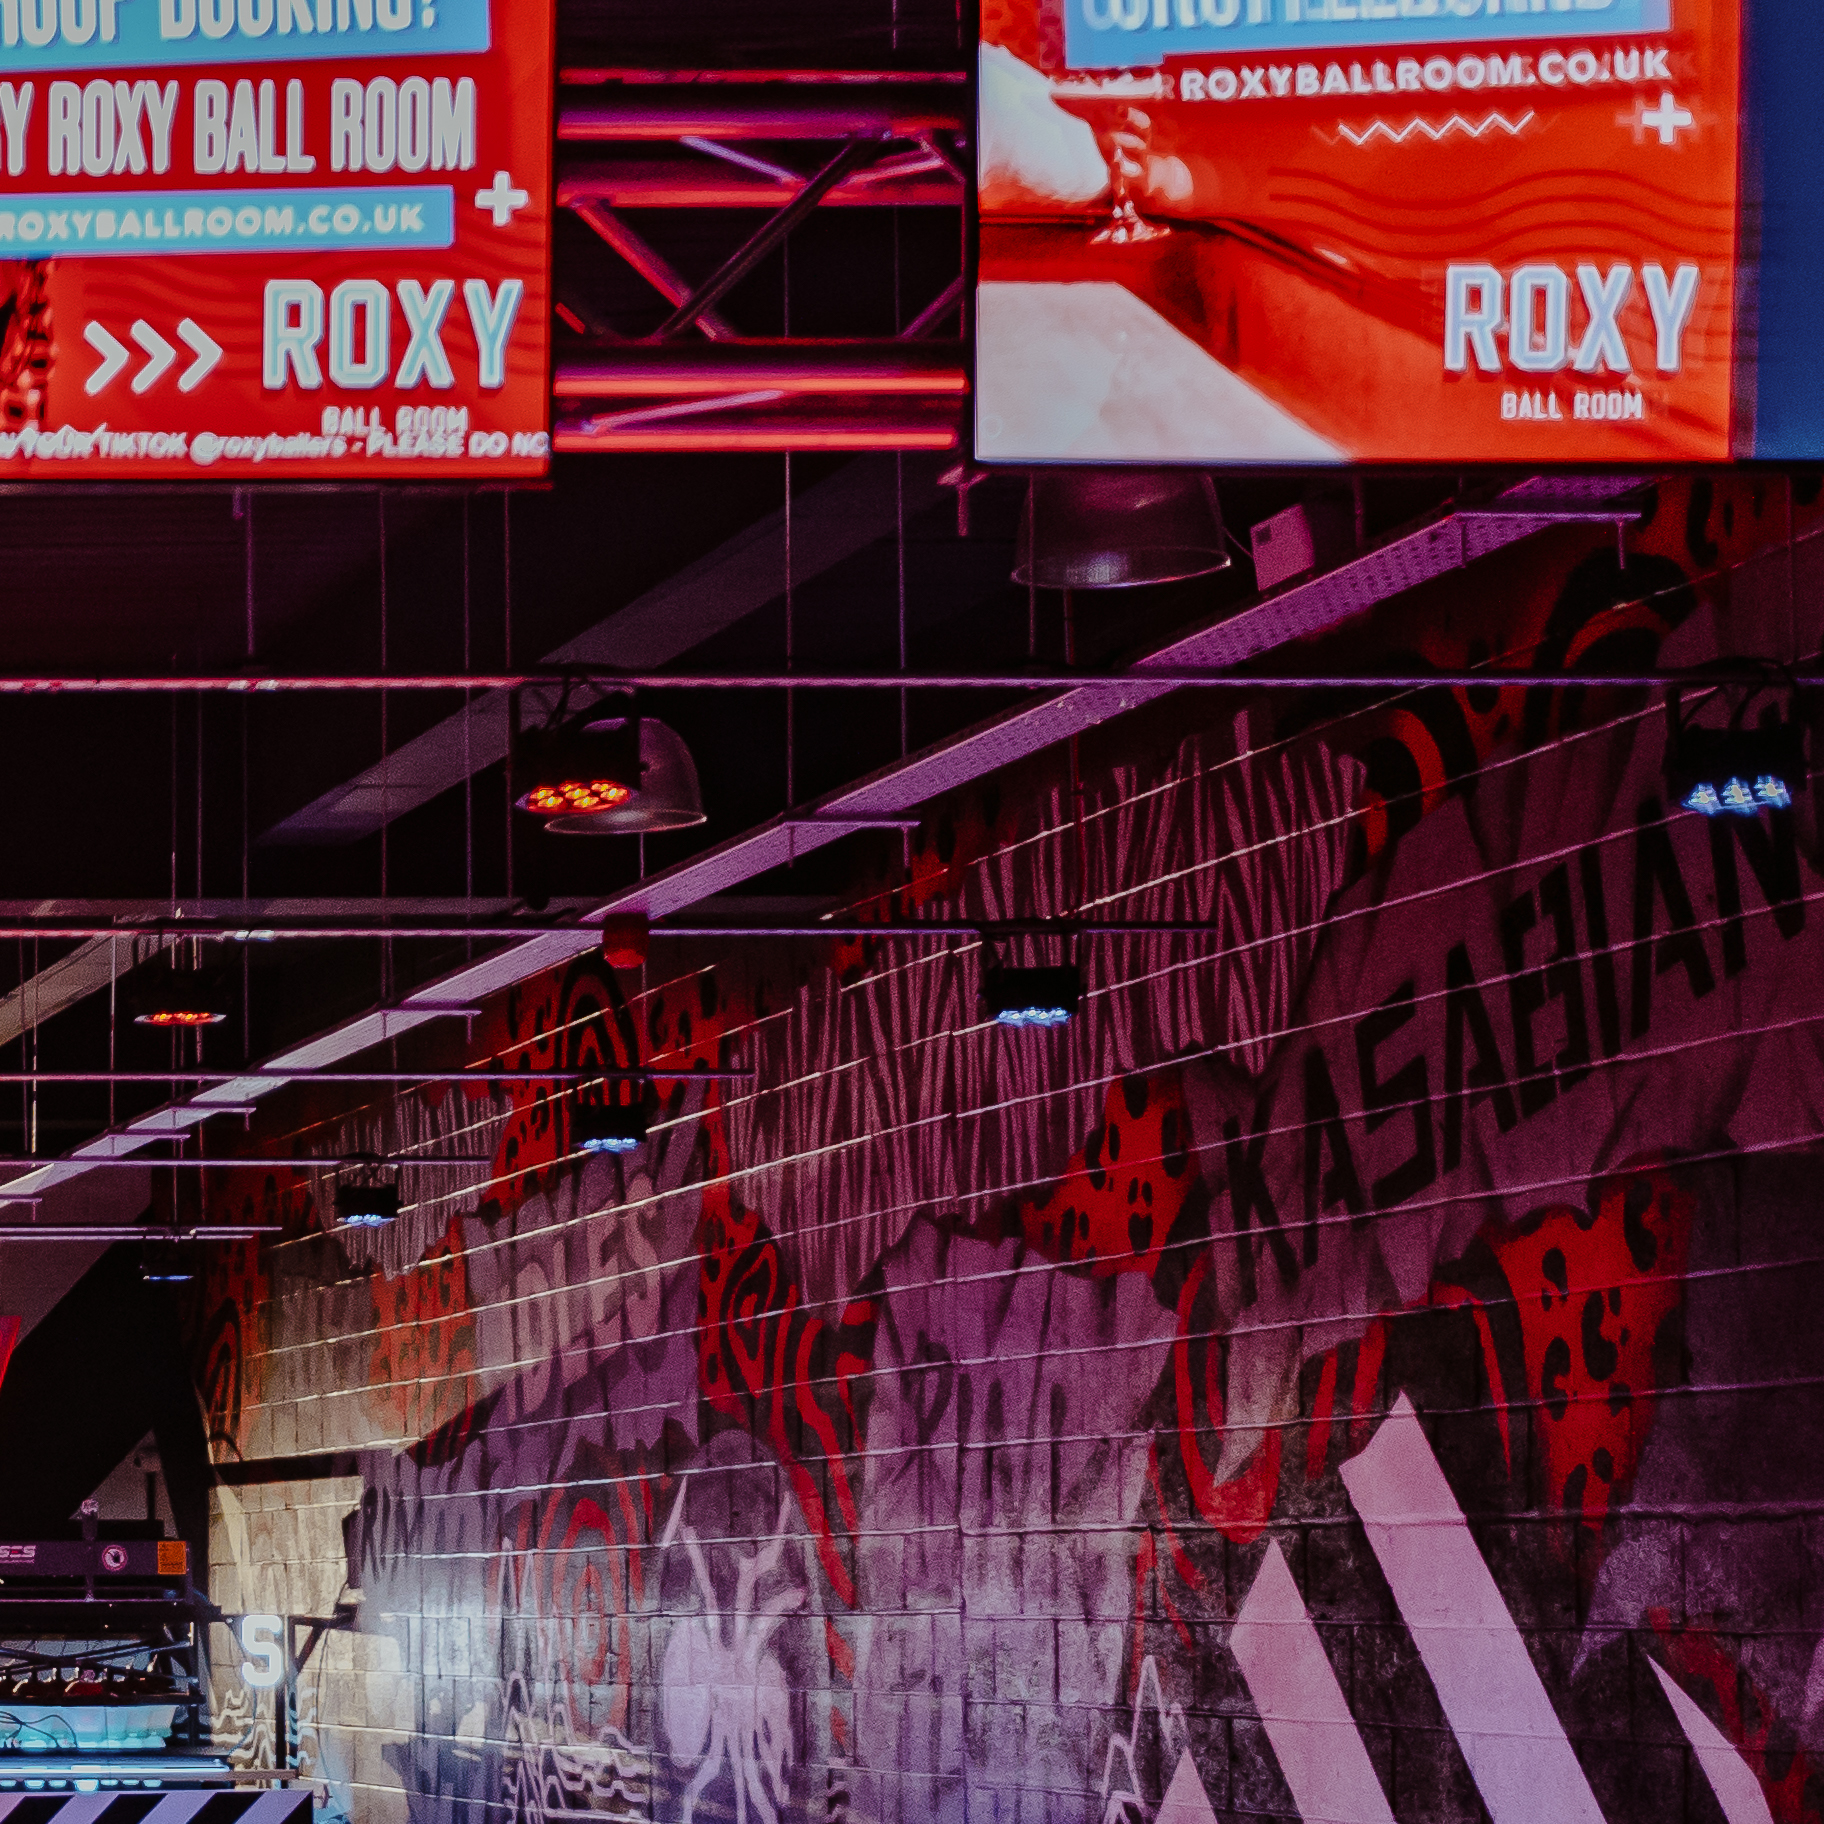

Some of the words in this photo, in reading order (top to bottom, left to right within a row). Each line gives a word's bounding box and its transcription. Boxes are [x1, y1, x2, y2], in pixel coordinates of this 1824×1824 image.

[1179, 48, 1670, 101] ROXYBALLROOM.CO.UK
[48, 79, 179, 178] ROXY
[193, 78, 316, 174] BALL
[331, 76, 476, 172] ROOM
[263, 279, 523, 389] ROXY
[1444, 263, 1700, 373] ROXY
[321, 406, 385, 436] BALL
[1501, 392, 1562, 420] BALL
[1573, 392, 1643, 420] ROOM
[468, 432, 508, 458] DO
[1224, 798, 1807, 1305] KASABIAN
[241, 1615, 283, 1687] 5
